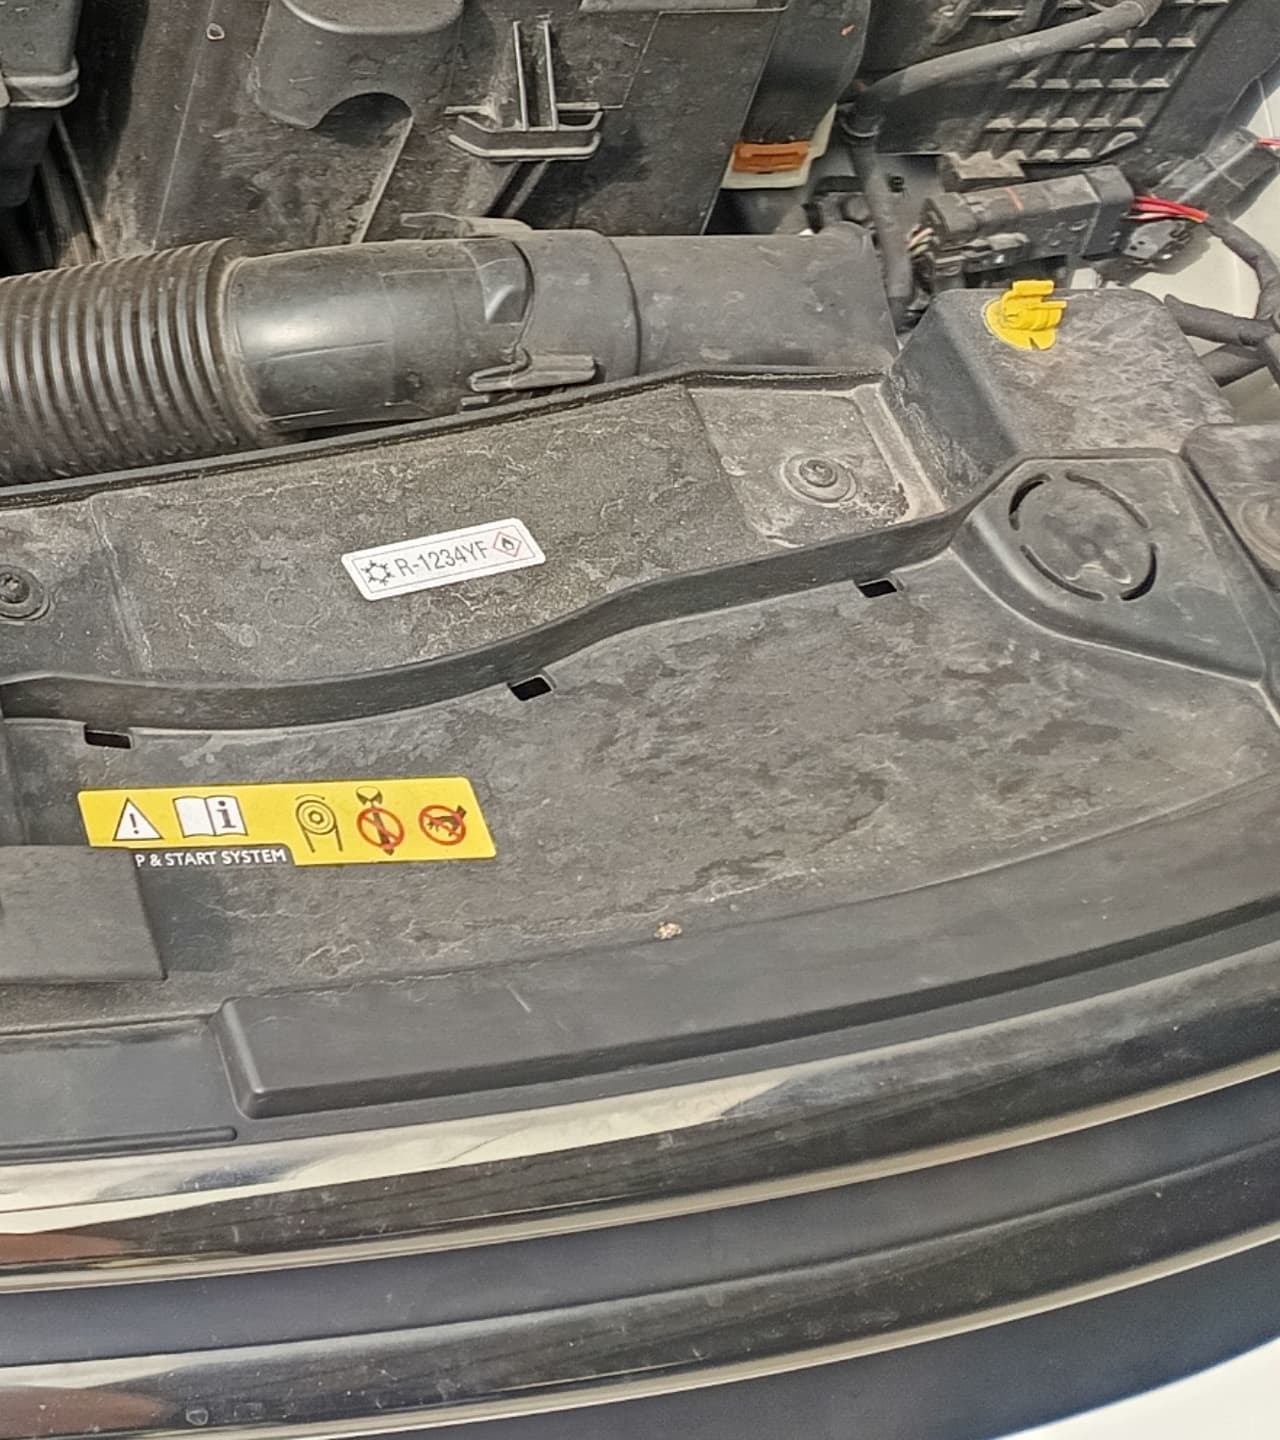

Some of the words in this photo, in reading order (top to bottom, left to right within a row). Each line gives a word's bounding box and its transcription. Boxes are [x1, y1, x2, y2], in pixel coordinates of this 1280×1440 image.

[394, 540, 489, 577] R-1234YF
[164, 851, 217, 867] START
[221, 848, 287, 865] SYSTEM
